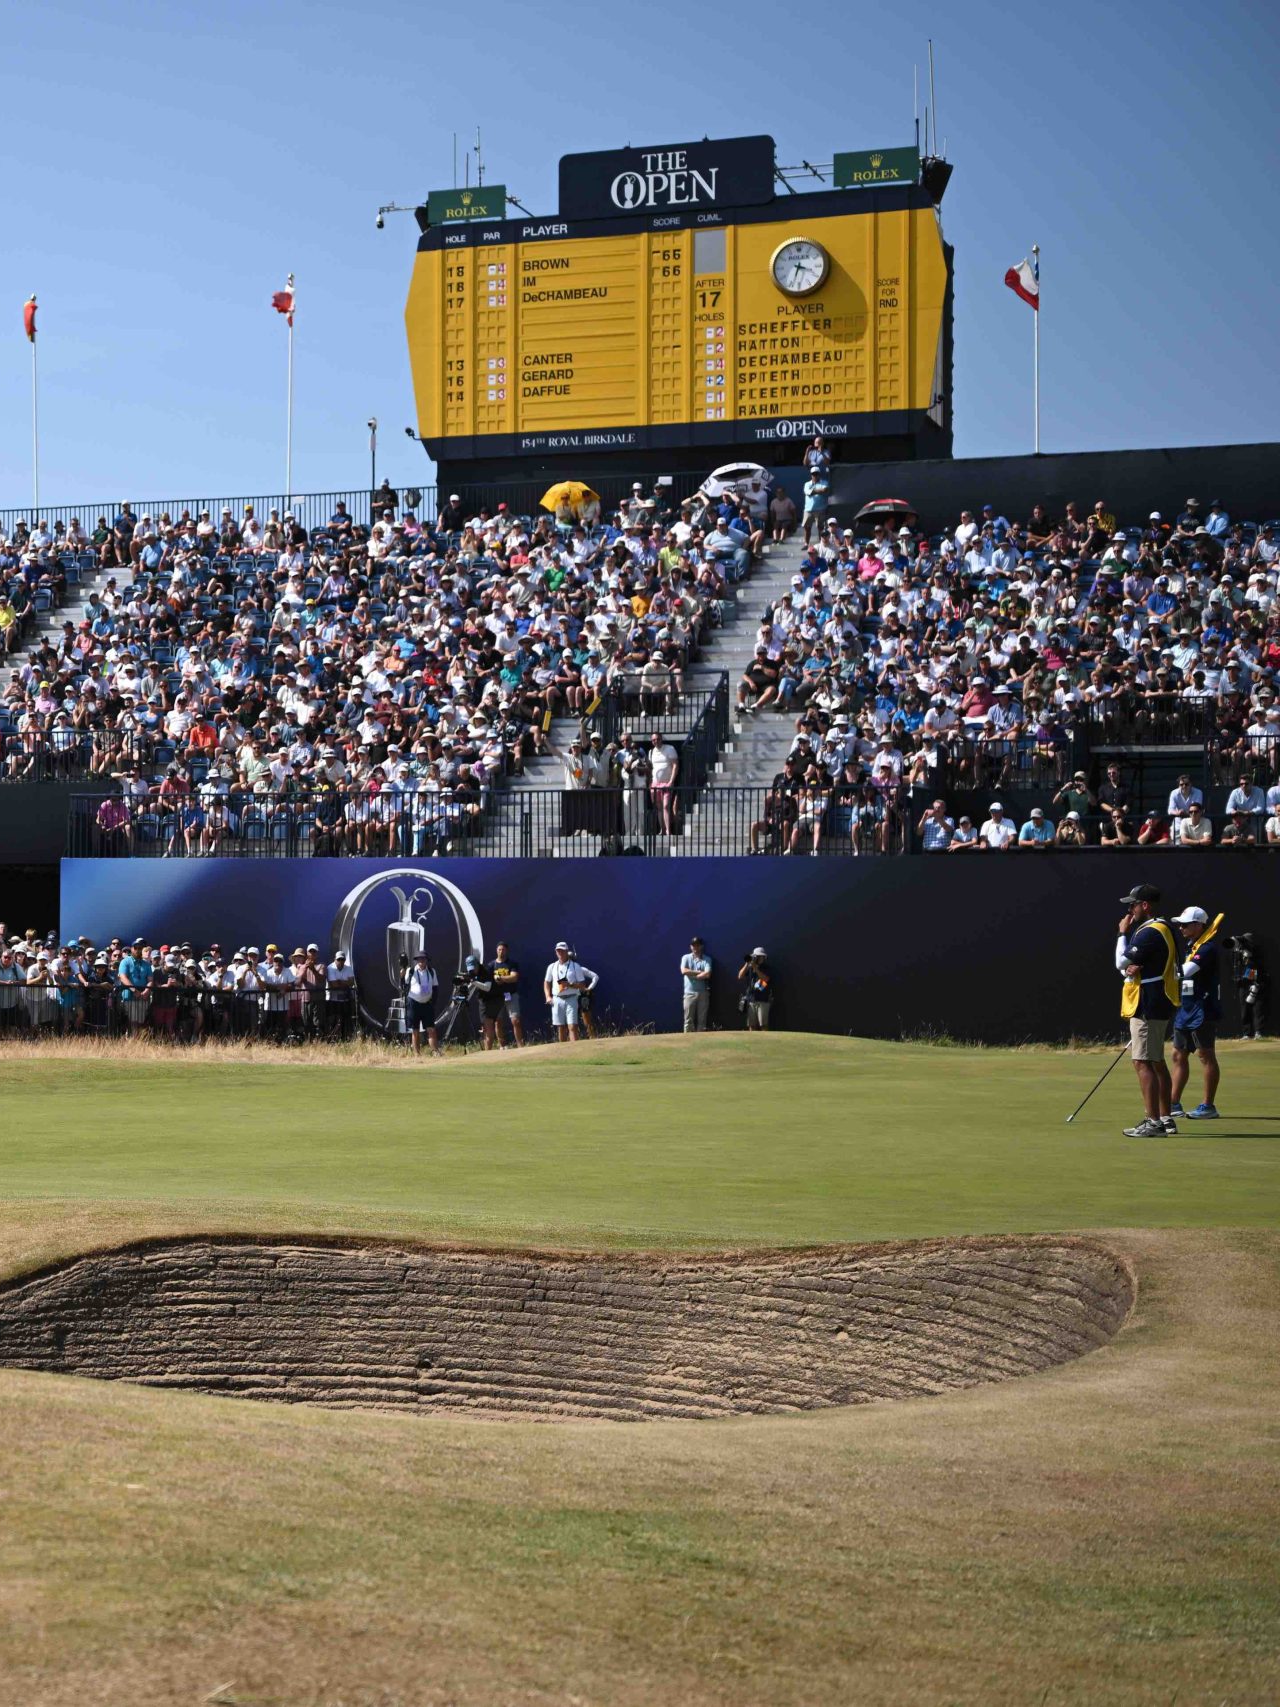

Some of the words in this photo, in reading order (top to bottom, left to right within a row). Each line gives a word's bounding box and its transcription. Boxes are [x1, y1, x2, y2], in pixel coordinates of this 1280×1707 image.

[642, 151, 687, 172] THE
[853, 168, 900, 182] ROLEX
[610, 167, 719, 209] OPEN
[446, 206, 488, 218] ROLEX
[445, 234, 467, 243] HOLE
[483, 231, 501, 240] PAR
[522, 224, 568, 237] PLAYER
[653, 217, 681, 227] SCORE
[447, 266, 465, 277] 18
[523, 257, 569, 271] BROWN
[447, 282, 465, 293] 18
[523, 277, 536, 286] IM
[662, 265, 681, 277] 66
[695, 279, 725, 288] AFTER
[877, 277, 900, 287] SCORE
[447, 297, 465, 309] 17
[523, 287, 608, 303] DeCHAMBEAU
[699, 292, 721, 308] 17
[881, 288, 896, 296] FOR
[777, 303, 824, 316] PLAYER
[879, 299, 898, 308] RND
[694, 312, 725, 321] HOLES
[738, 318, 832, 335] SCHEFFLER
[738, 337, 800, 351] HATTON
[447, 360, 465, 371] 13
[523, 353, 573, 366] CANTER
[738, 350, 843, 368] DECHAMBEAU
[447, 376, 465, 387] 16
[522, 369, 574, 382] GERARD
[738, 369, 800, 384] SPIETH
[447, 392, 465, 403] 14
[522, 385, 571, 398] DAFFUE
[738, 383, 832, 400] FLEETWOOD
[738, 403, 780, 417] RAHM
[548, 435, 582, 447] ROYAL
[584, 432, 636, 445] BIRKDALE
